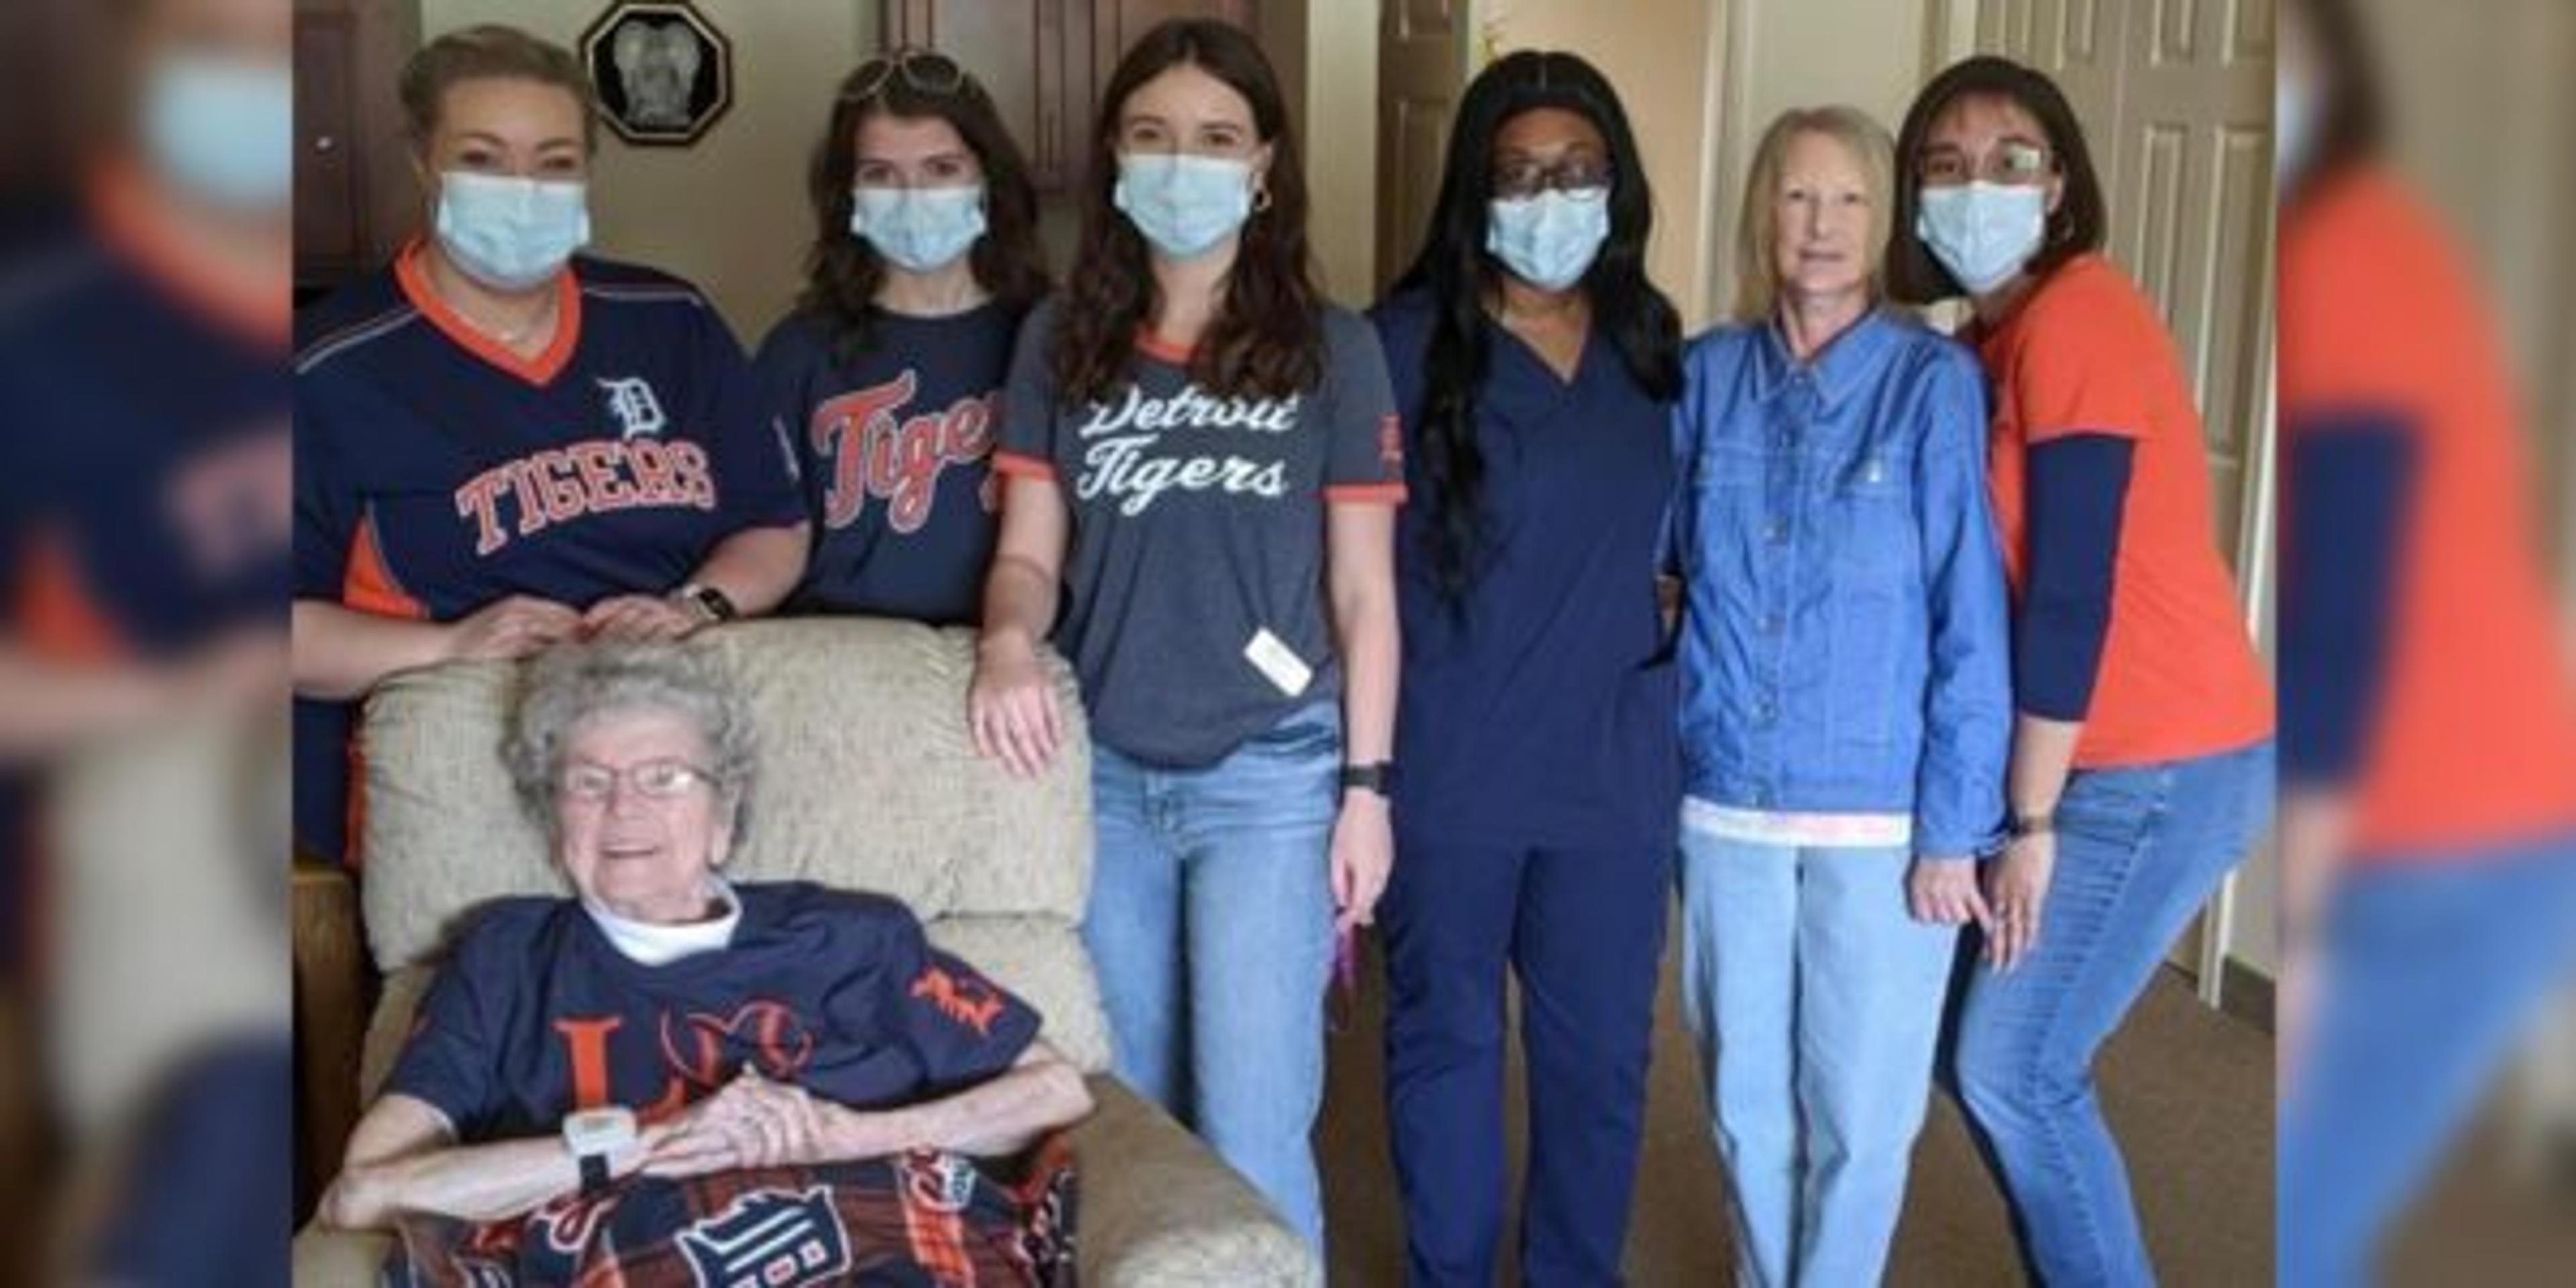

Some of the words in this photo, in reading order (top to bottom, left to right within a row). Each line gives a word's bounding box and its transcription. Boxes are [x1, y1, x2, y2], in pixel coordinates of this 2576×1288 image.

[596, 376, 666, 441] D
[810, 368, 1004, 533] Tige
[454, 438, 716, 555] TIGERS
[1076, 433, 1289, 517] Tigers
